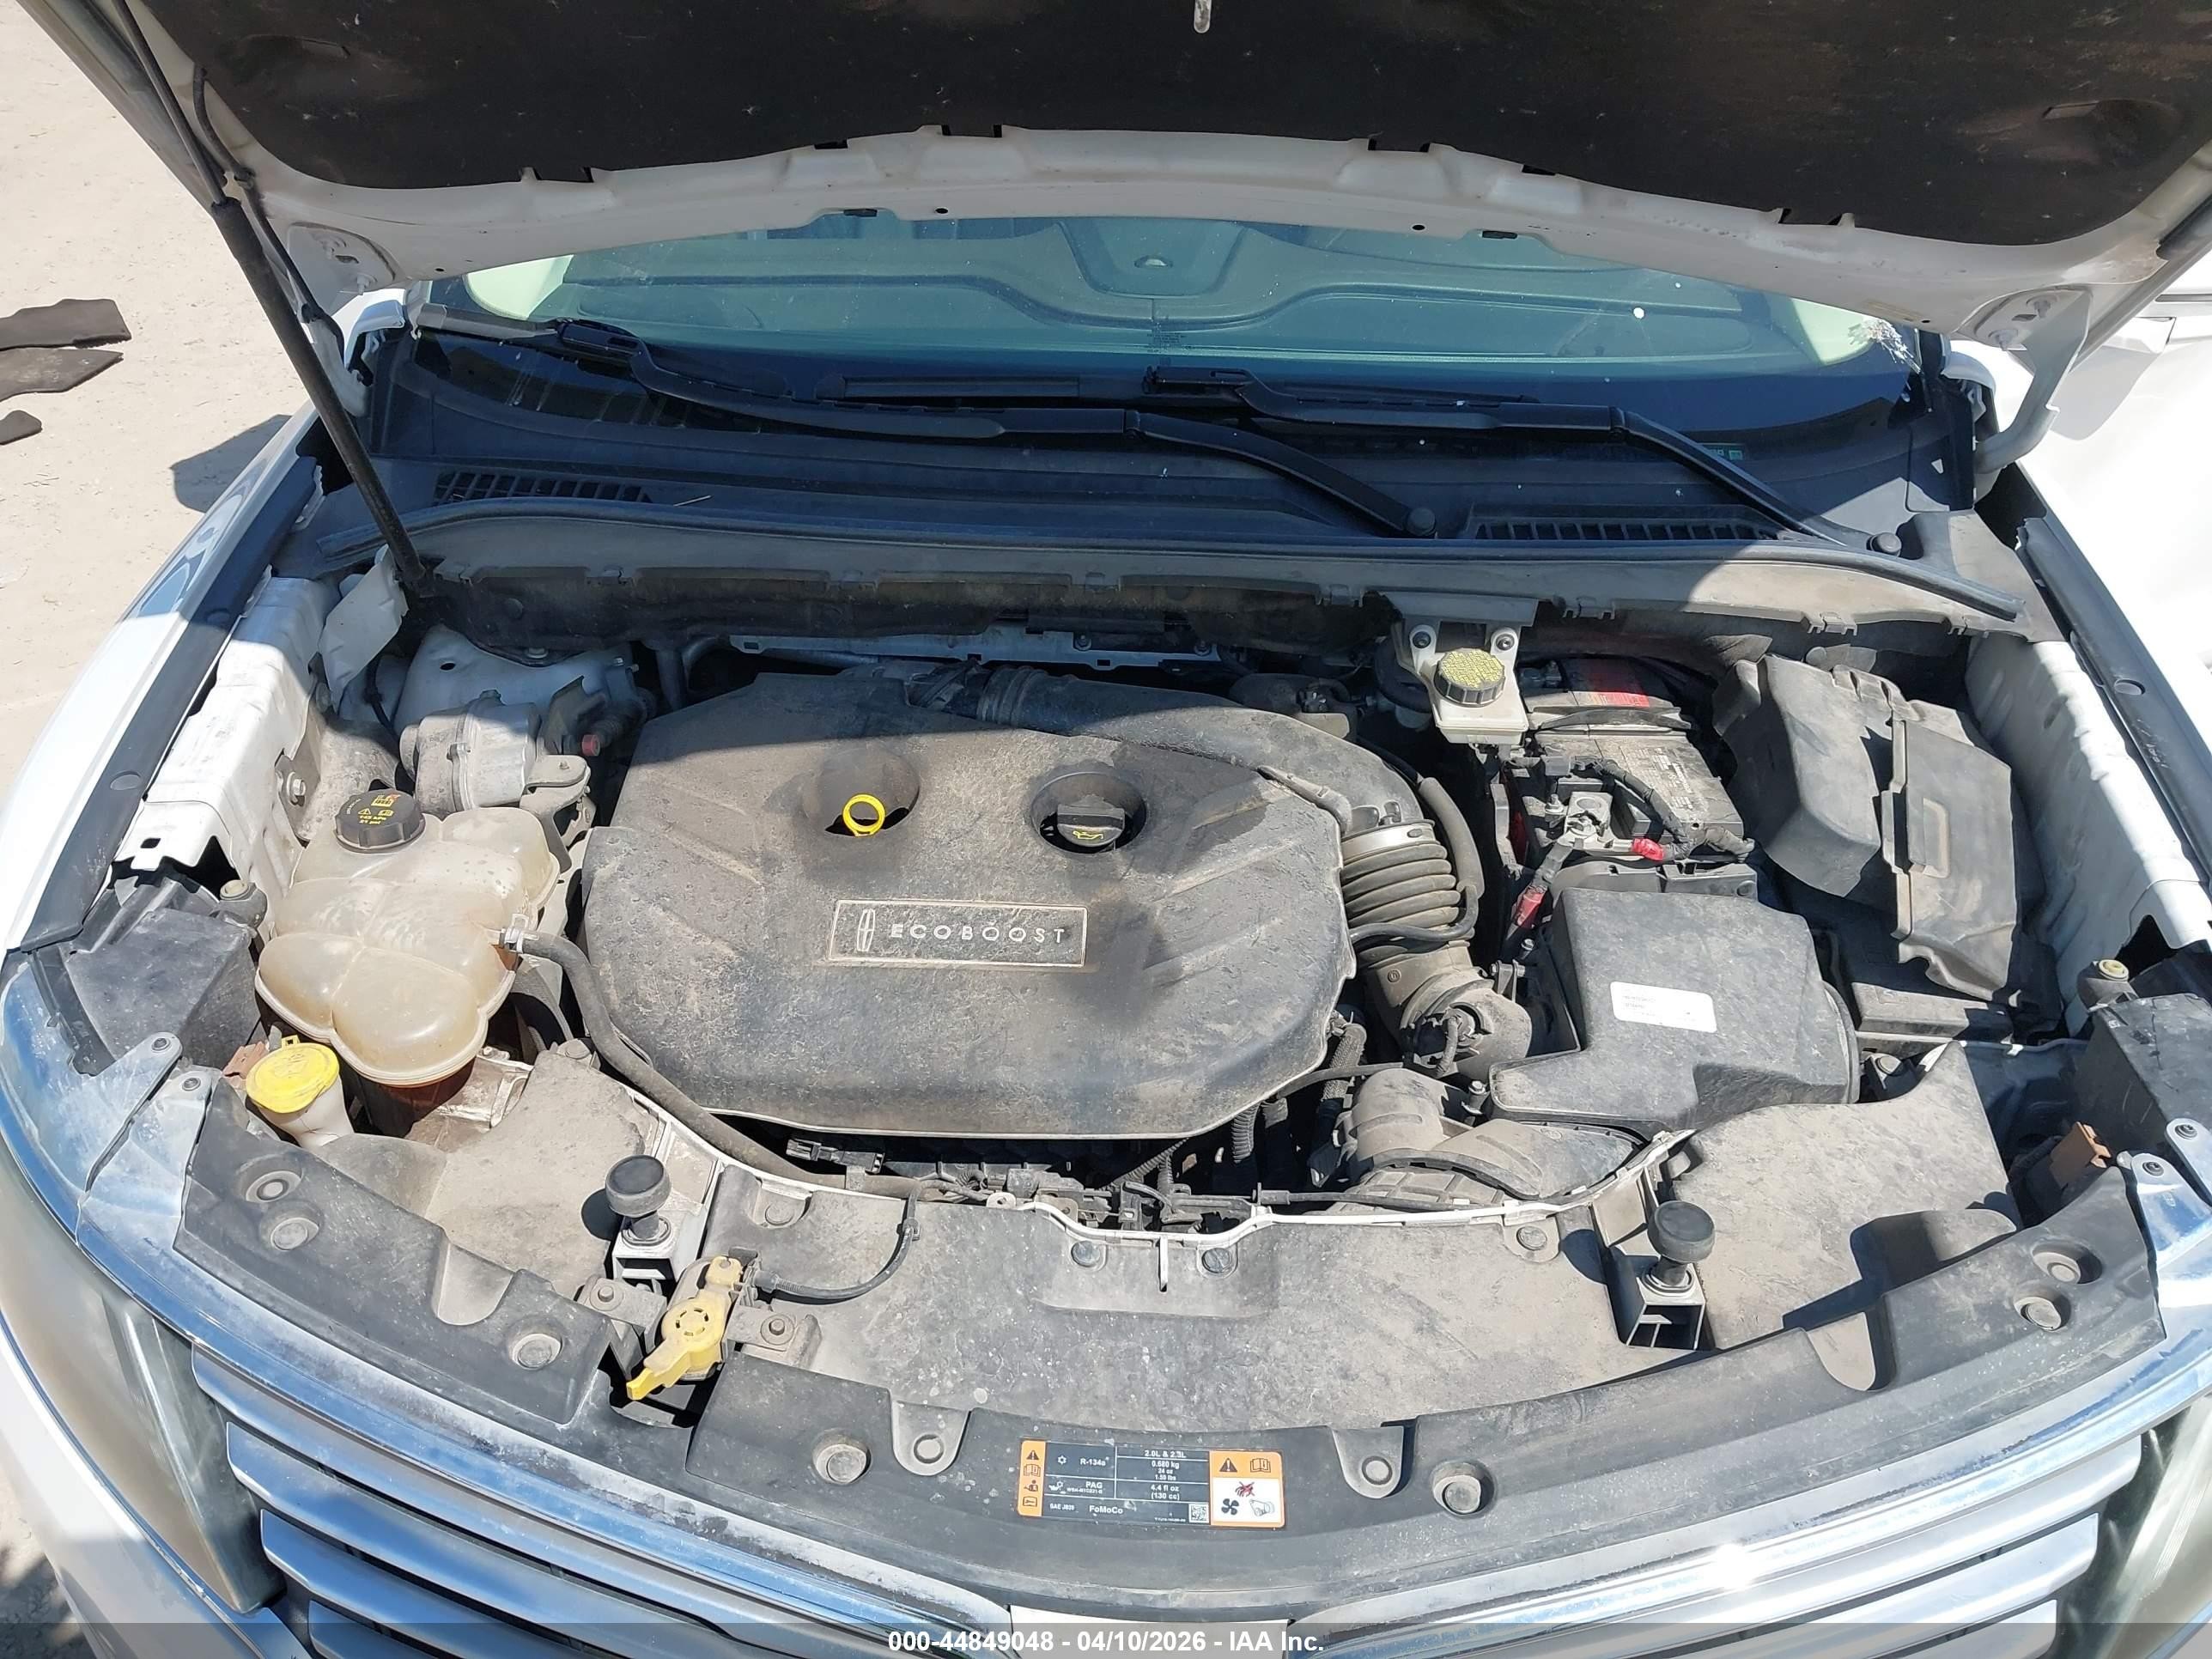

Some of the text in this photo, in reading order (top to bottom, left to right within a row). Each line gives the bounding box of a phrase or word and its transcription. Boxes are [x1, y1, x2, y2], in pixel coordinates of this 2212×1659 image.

[890, 923, 1065, 944] ECOBOOST
[1079, 1457, 1106, 1466] R-134a
[1170, 1461, 1180, 1469] kg
[1169, 1492, 1180, 1501] cc)
[1089, 1504, 1124, 1514] FoMoCo
